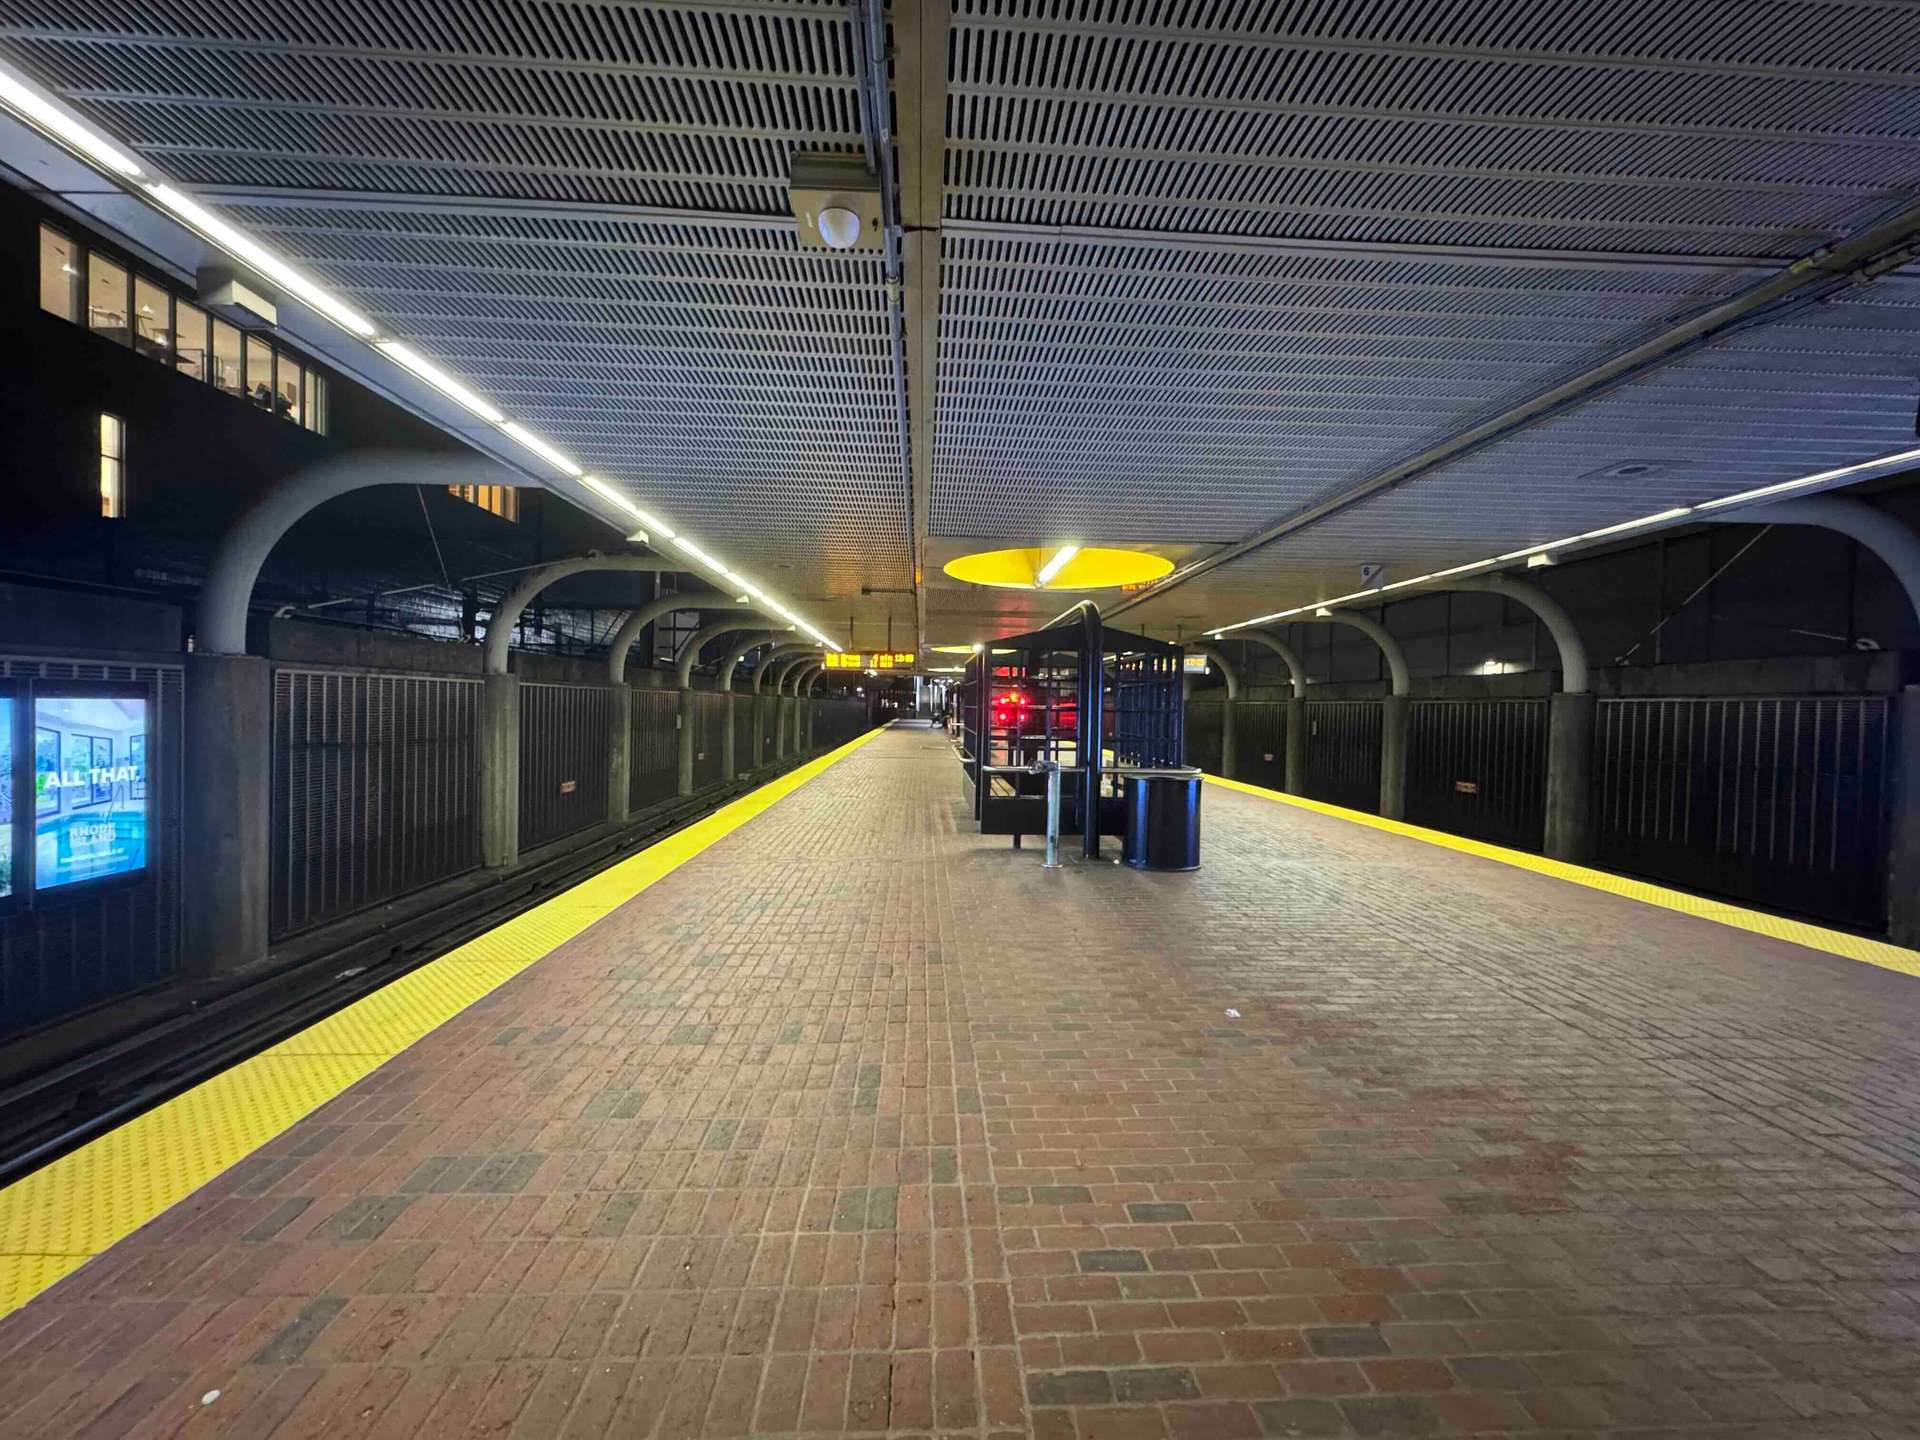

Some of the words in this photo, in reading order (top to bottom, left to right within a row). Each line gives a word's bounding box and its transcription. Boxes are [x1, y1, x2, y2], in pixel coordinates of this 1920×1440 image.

[1363, 566, 1370, 576] 6
[43, 770, 86, 789] ALL
[70, 822, 116, 837] RHODE
[70, 832, 116, 846] LAND
